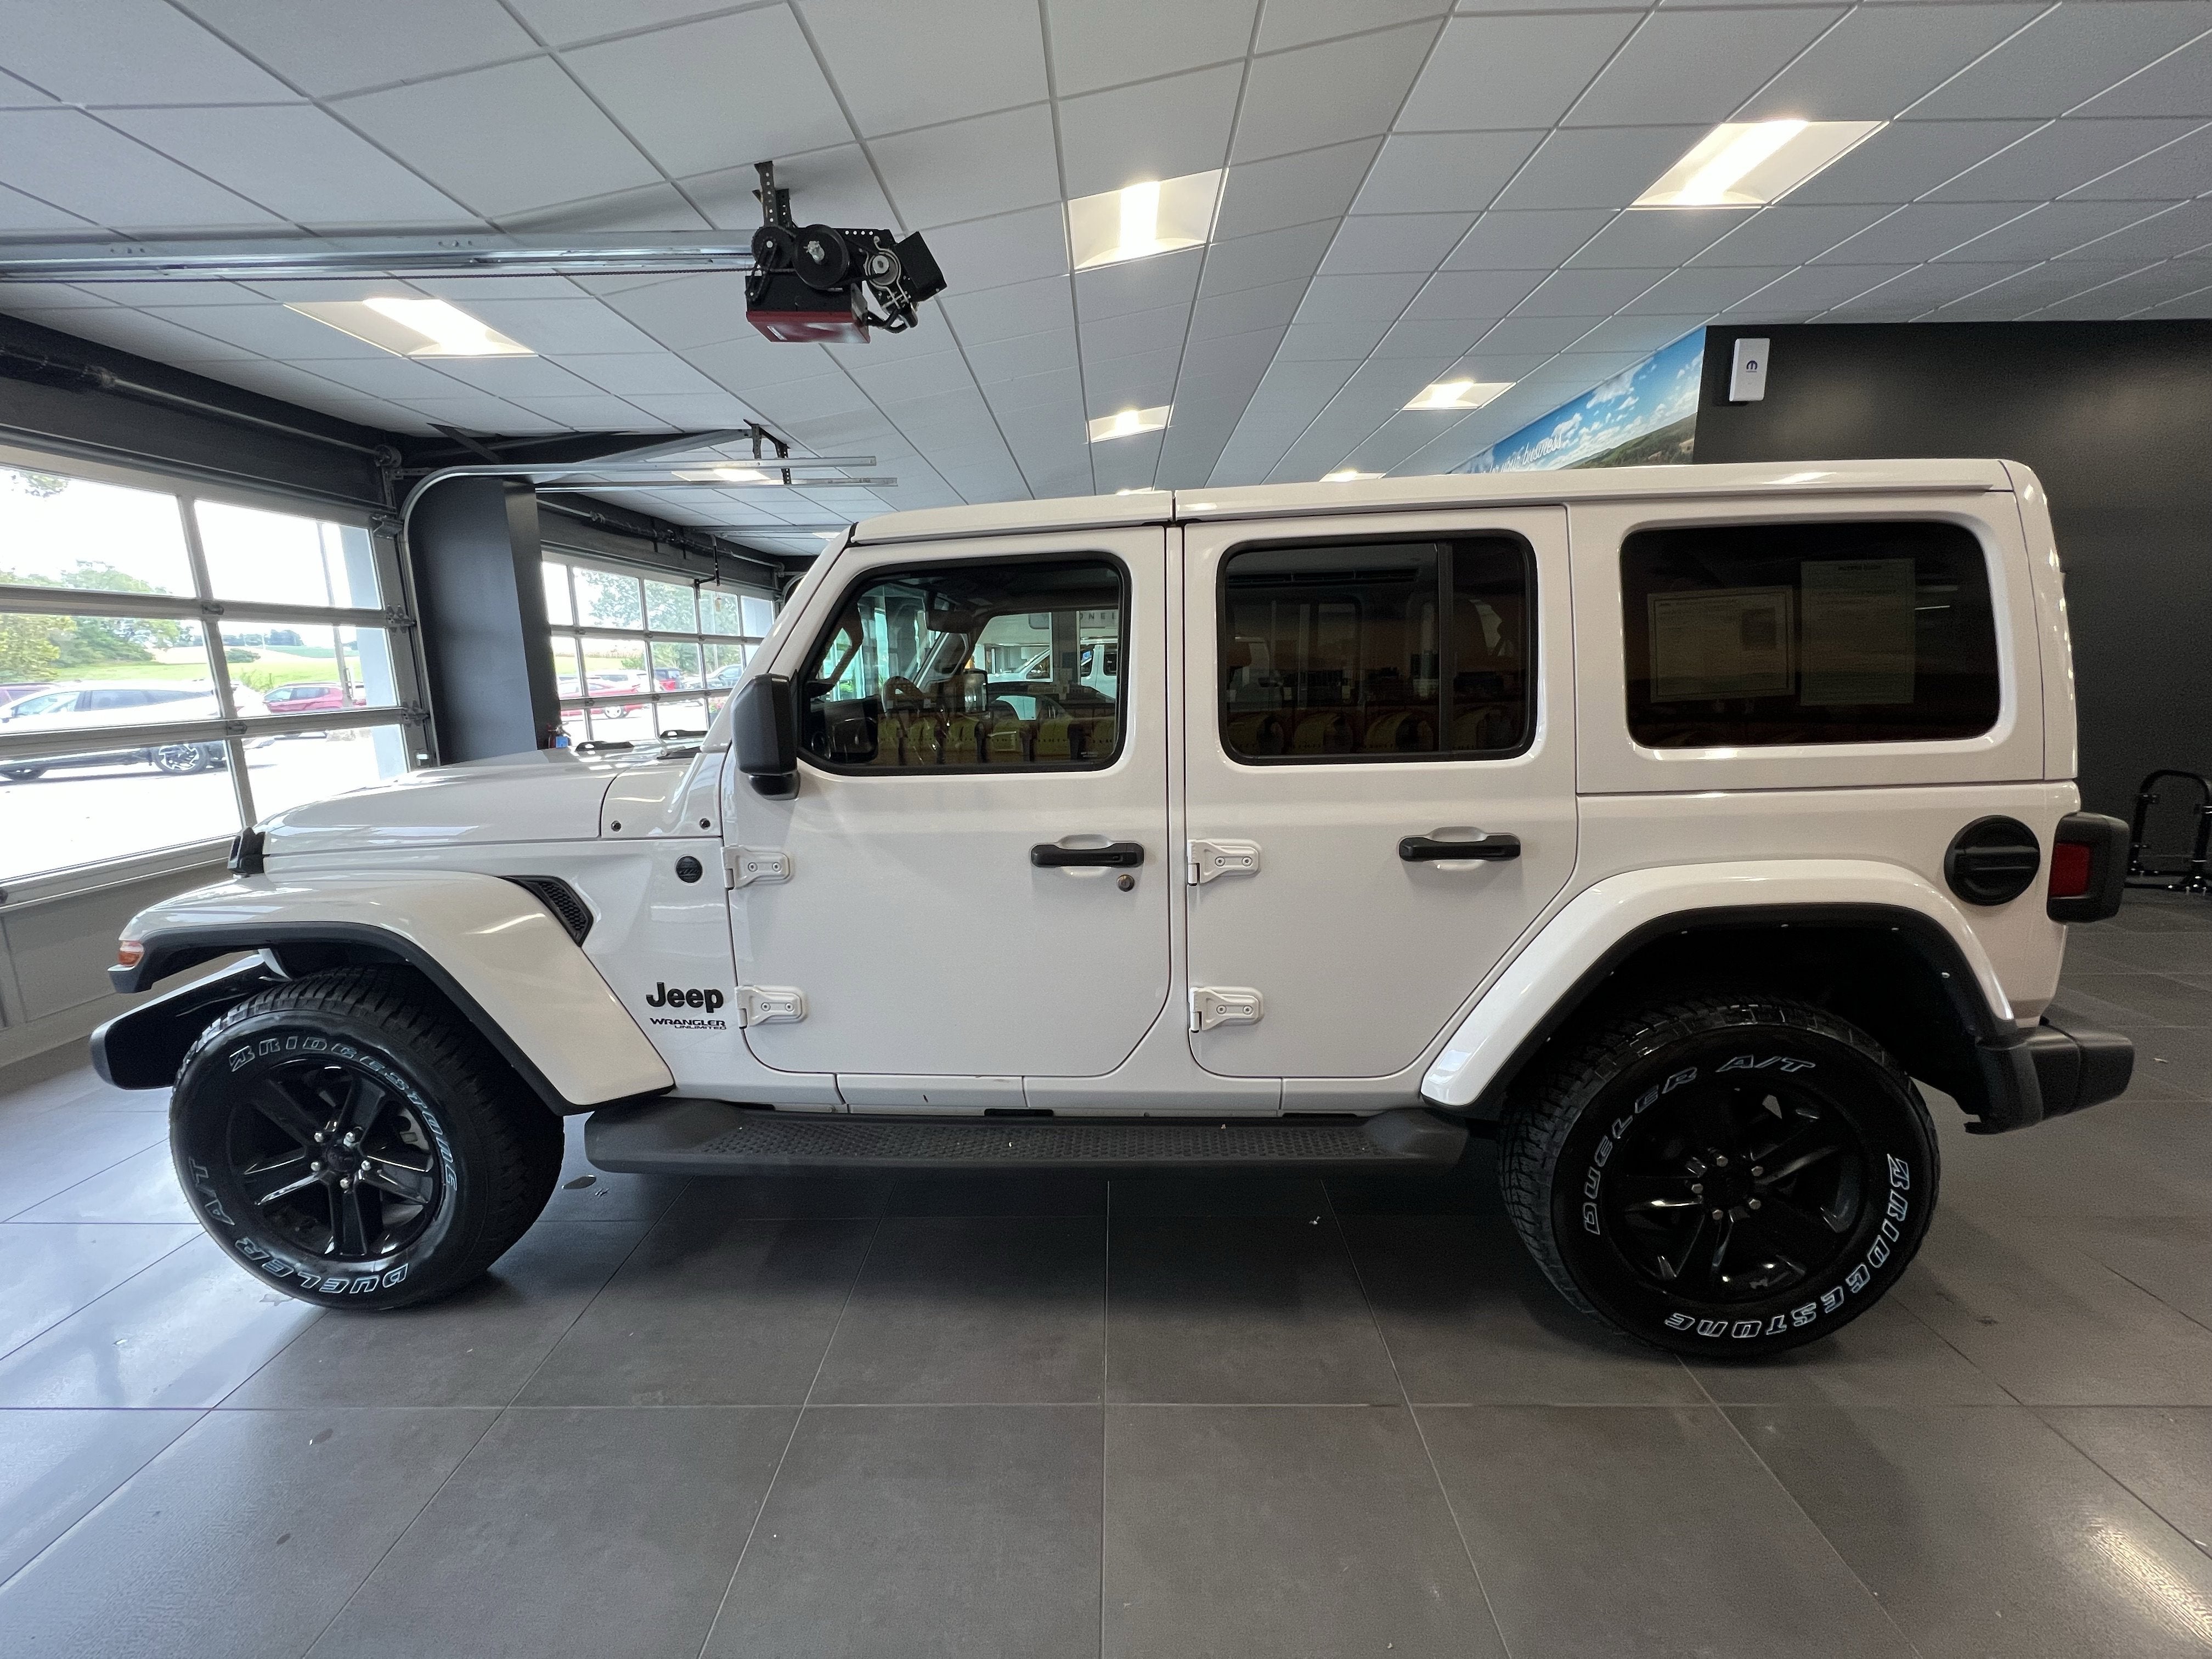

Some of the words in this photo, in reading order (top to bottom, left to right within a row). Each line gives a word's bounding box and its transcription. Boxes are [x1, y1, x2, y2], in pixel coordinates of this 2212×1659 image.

[1522, 433, 1562, 465] business
[646, 982, 724, 1013] Jeep
[650, 1018, 725, 1026] WRANGLER
[229, 1036, 458, 1191] BRIDGESTONE
[1583, 1066, 1697, 1235] DUELER
[1715, 1054, 1816, 1073] A/T
[235, 1237, 409, 1294] DUELER
[1664, 1153, 1909, 1339] BRIDGESTONE
